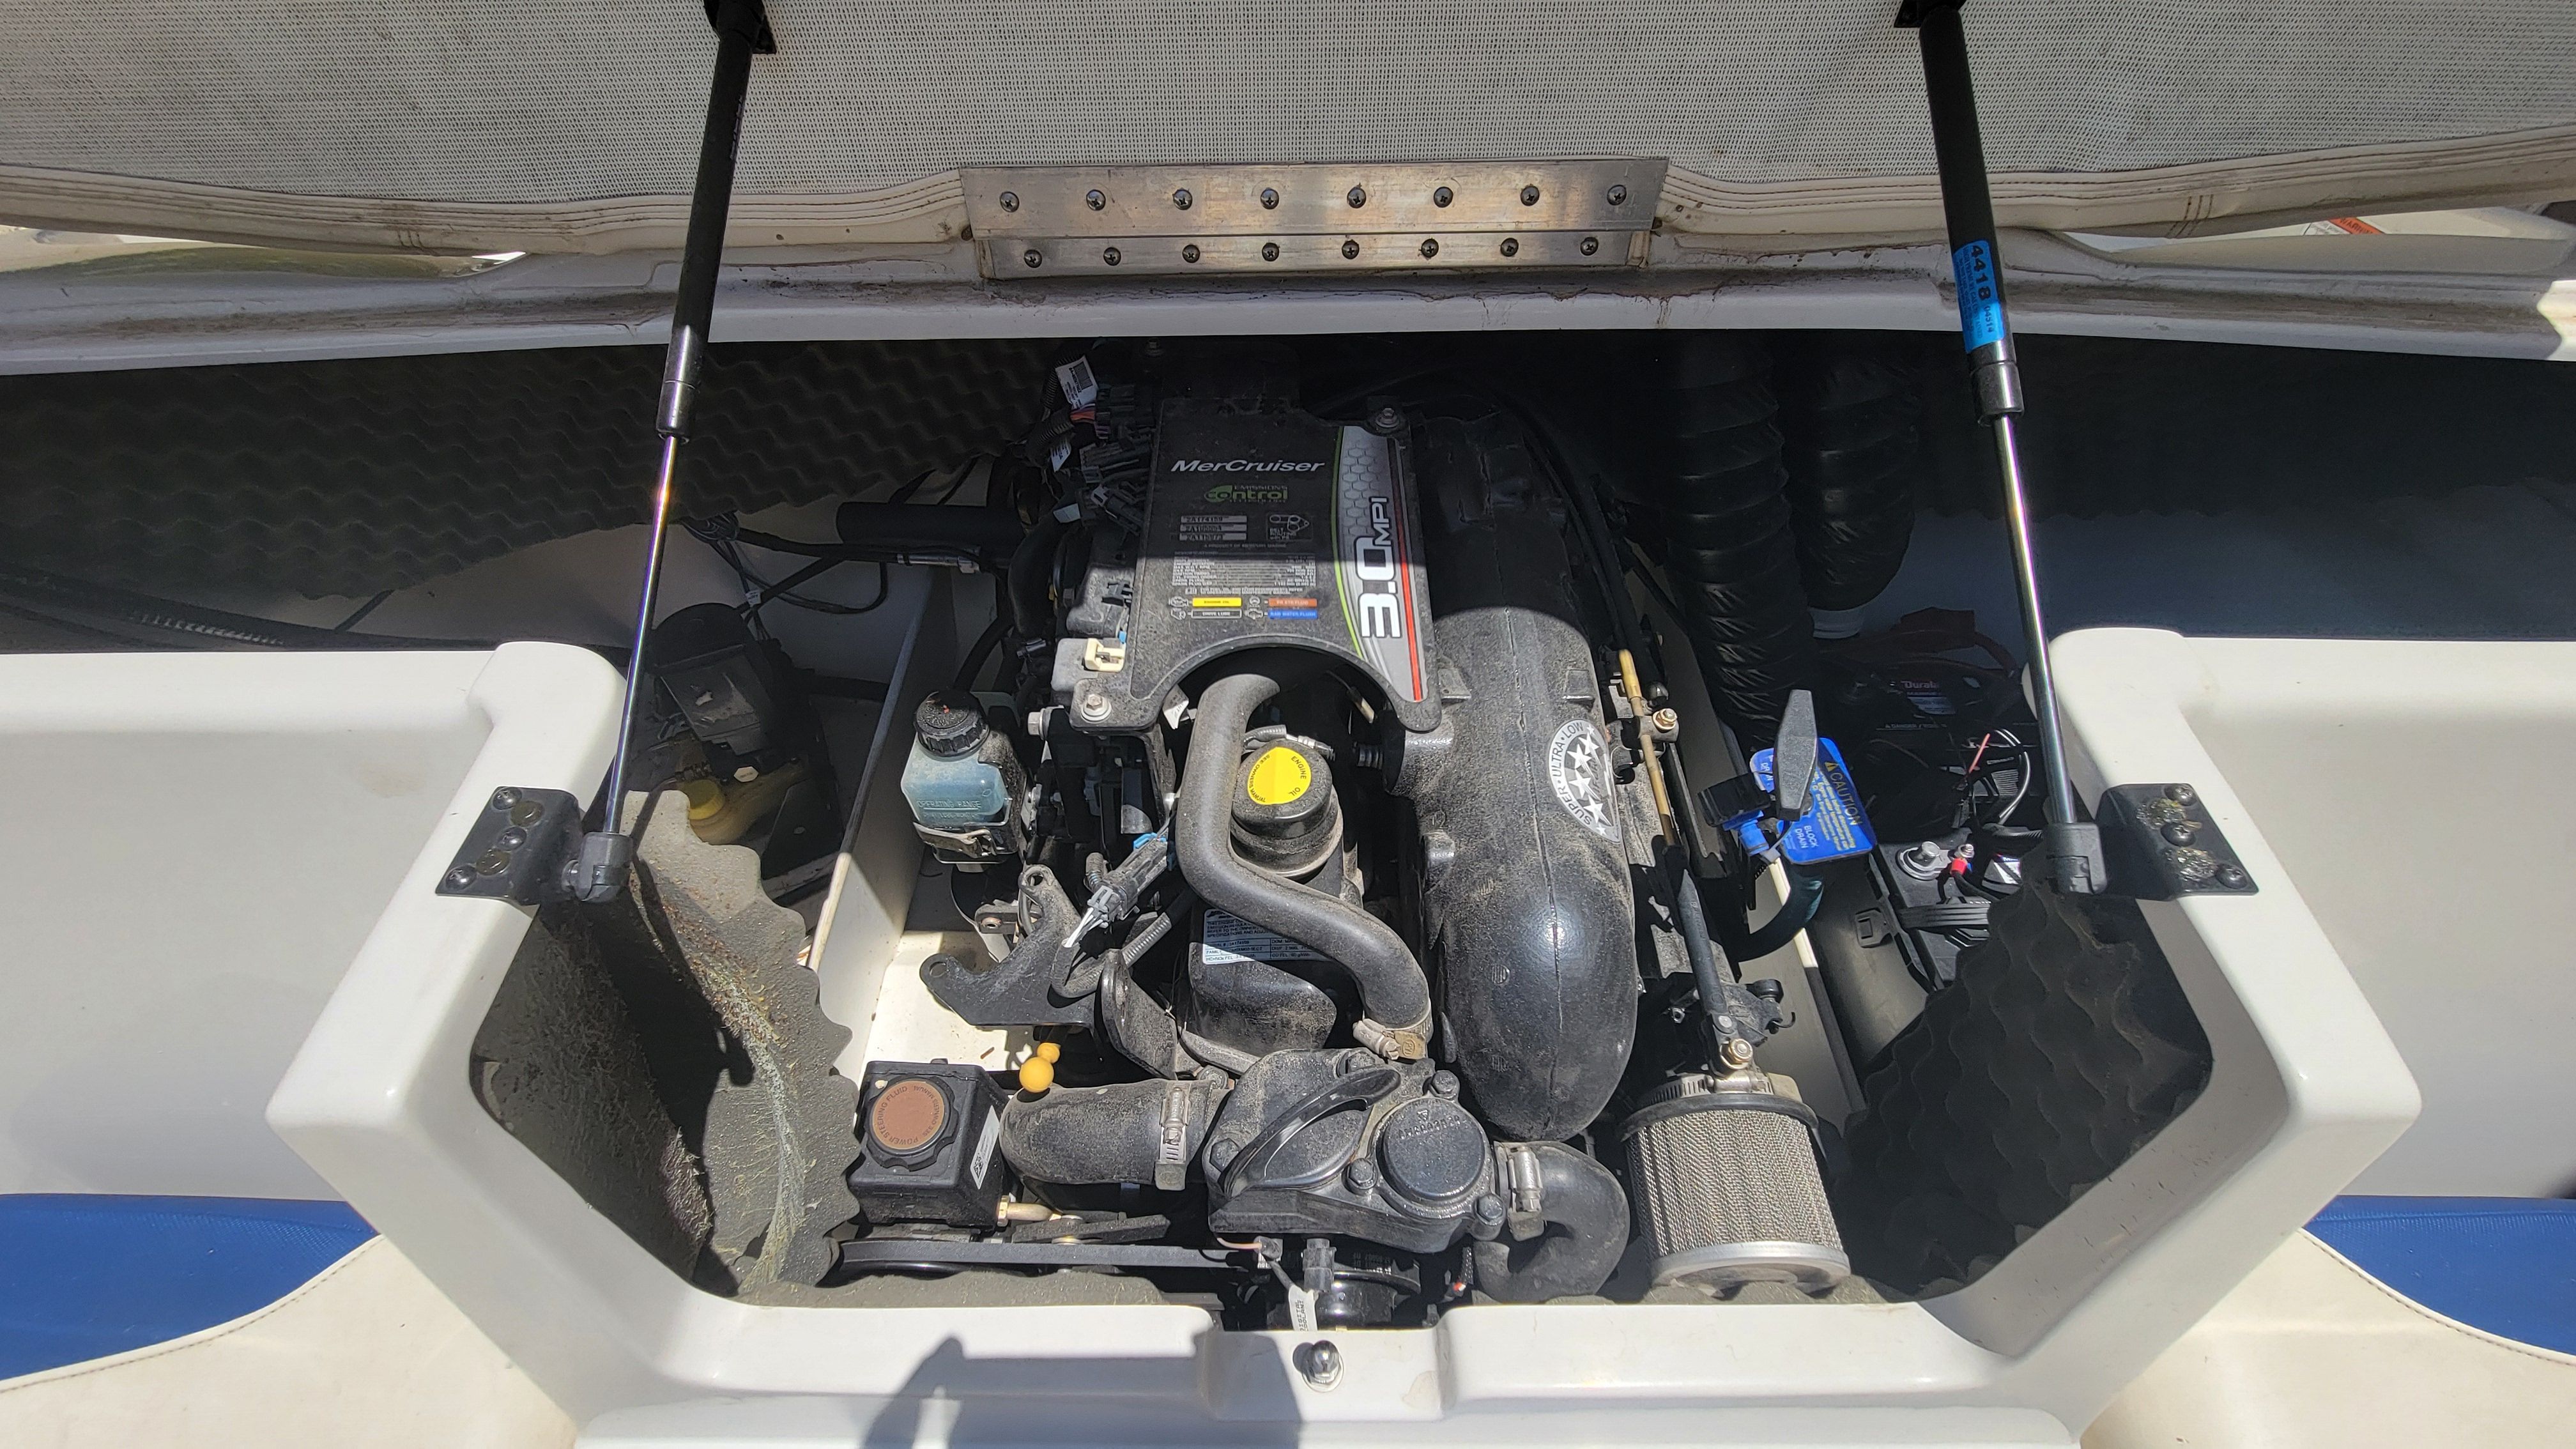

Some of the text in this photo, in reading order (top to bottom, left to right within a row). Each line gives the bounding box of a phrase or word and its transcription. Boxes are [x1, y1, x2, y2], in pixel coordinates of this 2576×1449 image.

[1972, 245, 1991, 300] 4418
[1171, 459, 1325, 472] MerCruiser
[1370, 496, 1392, 546] MPI
[1355, 535, 1402, 638] 3.0
[1259, 755, 1270, 764] SEE
[1288, 756, 1307, 796] ENGINE OIL
[1551, 722, 1591, 825] SUPER ULTRA LOW
[958, 800, 982, 808] RANGE
[1250, 788, 1266, 802] MANUAL
[1830, 772, 1863, 825] CAUTION
[1795, 828, 1809, 848] DRAIN
[1804, 825, 1819, 848] BLOCK
[877, 1085, 919, 1146] POWER STEERING FLUID
[913, 1085, 940, 1137] SEE OWNERS MANUAL
